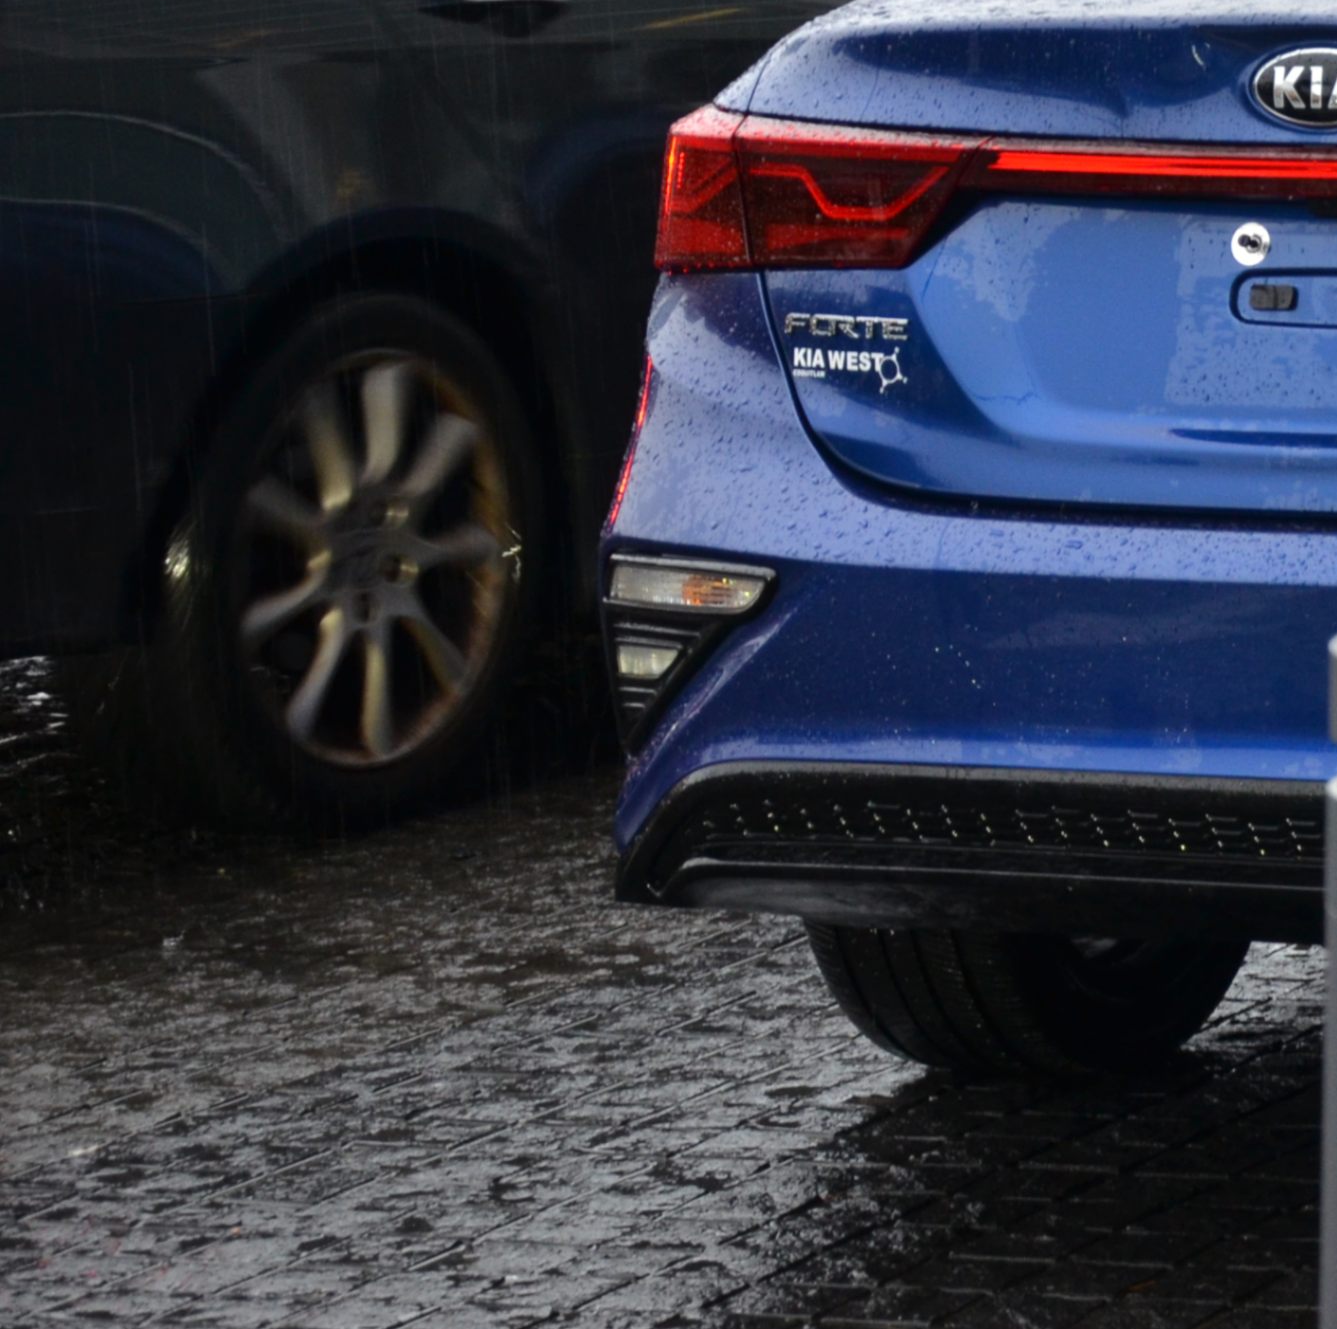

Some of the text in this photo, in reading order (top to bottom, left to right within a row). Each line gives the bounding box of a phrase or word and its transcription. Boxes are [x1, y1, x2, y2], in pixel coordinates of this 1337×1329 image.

[784, 312, 908, 340] FORTE
[793, 347, 885, 372] KIA WEST
